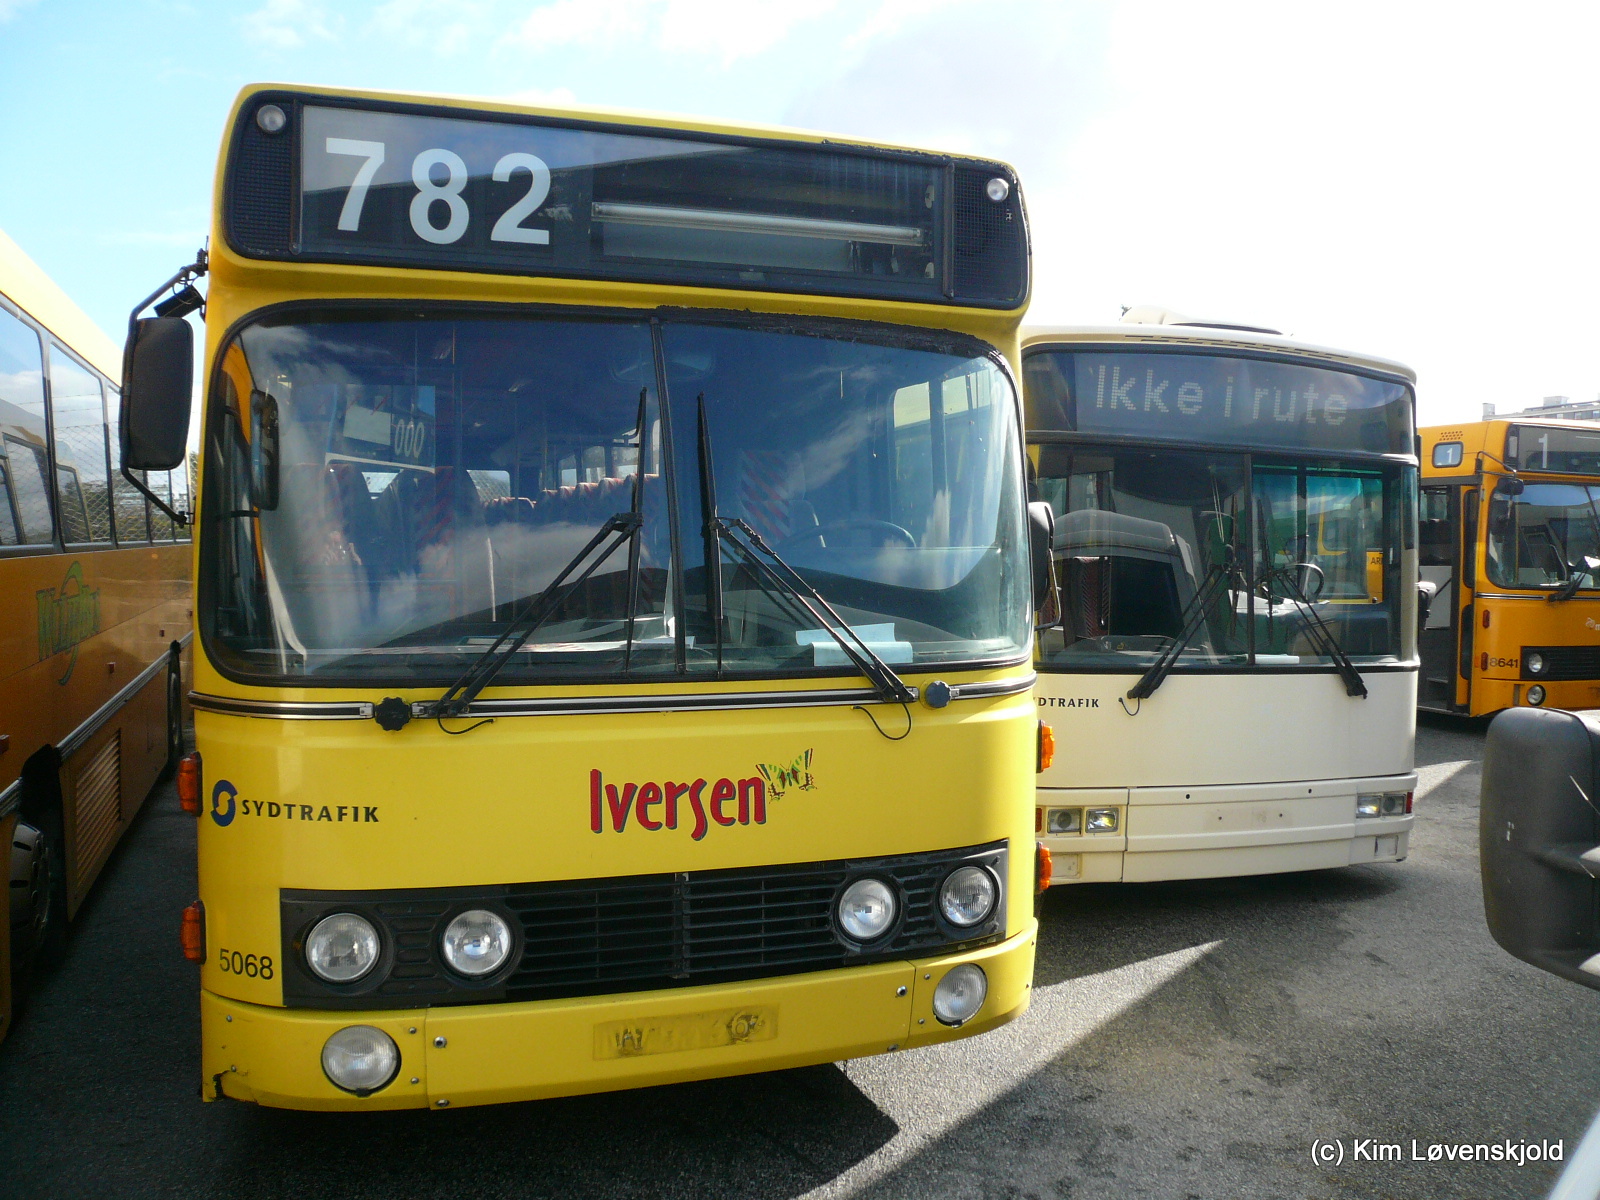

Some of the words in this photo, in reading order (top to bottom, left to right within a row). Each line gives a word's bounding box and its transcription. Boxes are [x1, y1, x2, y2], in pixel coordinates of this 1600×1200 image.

[325, 137, 551, 245] 782
[1096, 365, 1204, 415] Ikke
[1224, 376, 1234, 418] i
[1252, 383, 1349, 426] rute
[1538, 433, 1549, 469] 1
[1490, 657, 1519, 669] 8641
[1033, 696, 1100, 708] DTRAFIK
[242, 799, 380, 823] SYDTRAFIK
[590, 768, 767, 842] Iversen
[219, 948, 275, 981] 5068
